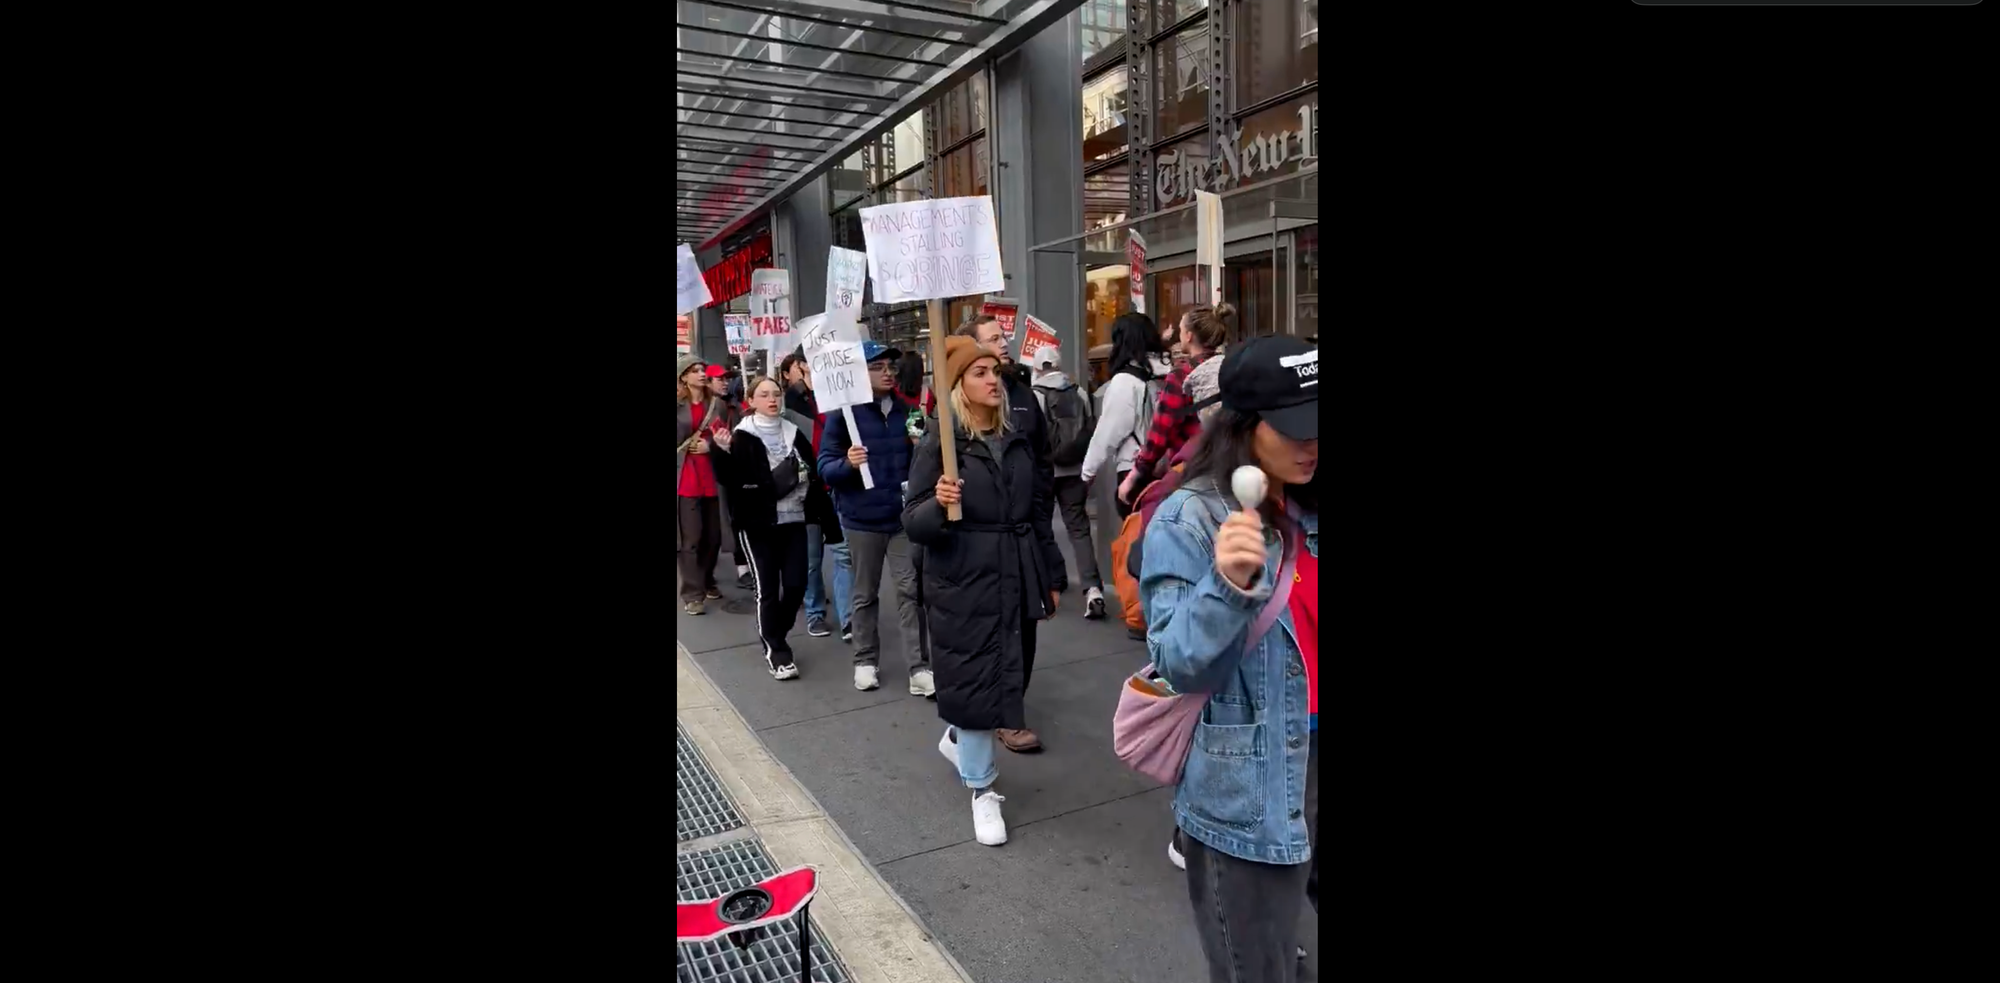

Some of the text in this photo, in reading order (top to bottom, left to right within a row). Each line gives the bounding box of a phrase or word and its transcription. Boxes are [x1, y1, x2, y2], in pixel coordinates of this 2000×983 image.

[1156, 149, 1212, 204] The
[1211, 126, 1291, 192] New
[869, 204, 988, 234] MANAGEMENT'S
[900, 231, 964, 256] STALLING
[763, 298, 778, 314] IT
[751, 316, 790, 336] TAKES
[803, 324, 837, 349] JUST
[812, 348, 855, 374] CAUSE
[825, 370, 855, 396] NOW
